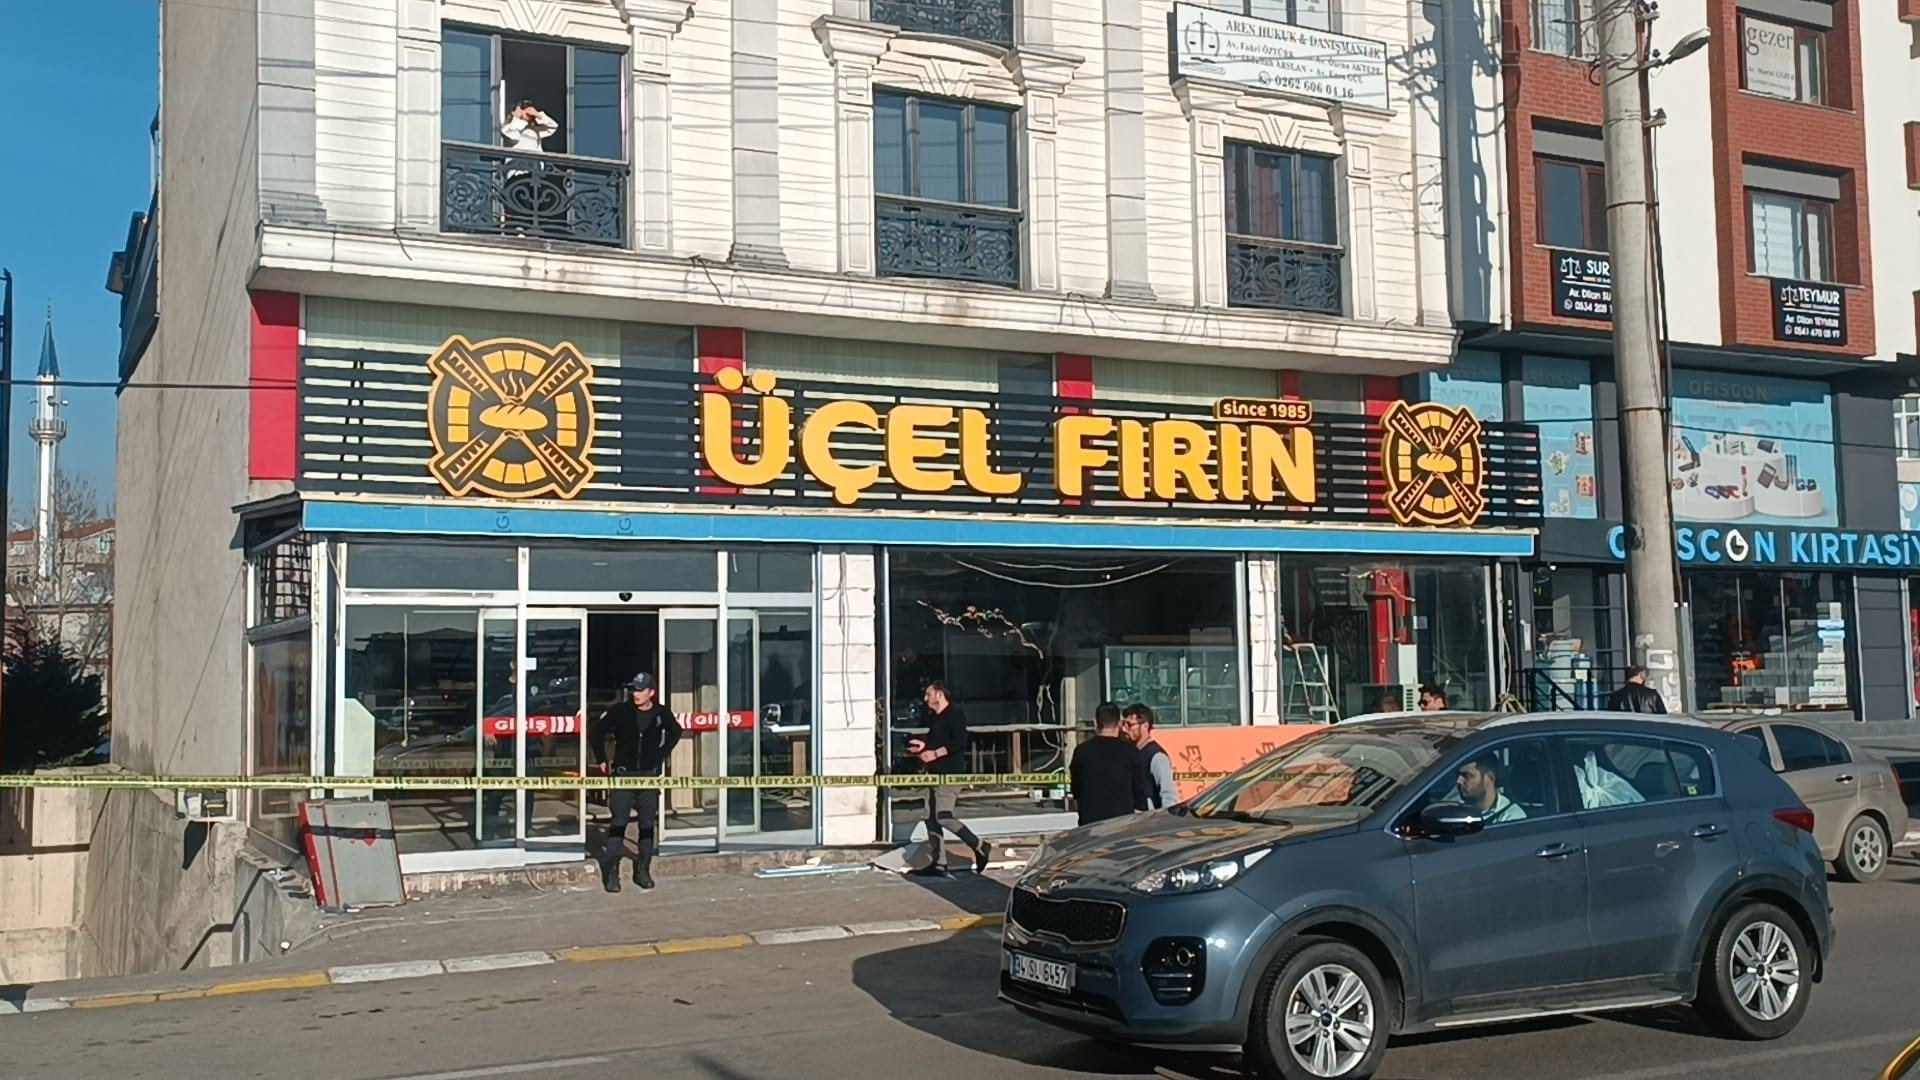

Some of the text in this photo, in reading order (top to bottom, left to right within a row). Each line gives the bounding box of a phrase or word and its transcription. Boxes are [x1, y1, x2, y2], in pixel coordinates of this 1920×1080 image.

[1258, 25, 1297, 43] HUKUK
[1297, 33, 1308, 45] &
[1746, 27, 1793, 56] gezer
[1274, 75, 1301, 90] 0262
[1587, 260, 1611, 276] SUR
[1602, 291, 1612, 301] SU
[1798, 287, 1840, 304] TEYMUR
[1223, 400, 1307, 419] since 1985
[703, 367, 1316, 505] ÜÇEL FIRIN
[1607, 525, 1775, 563] OSCON
[1029, 960, 1040, 980] SL
[1043, 963, 1067, 987] 6457
